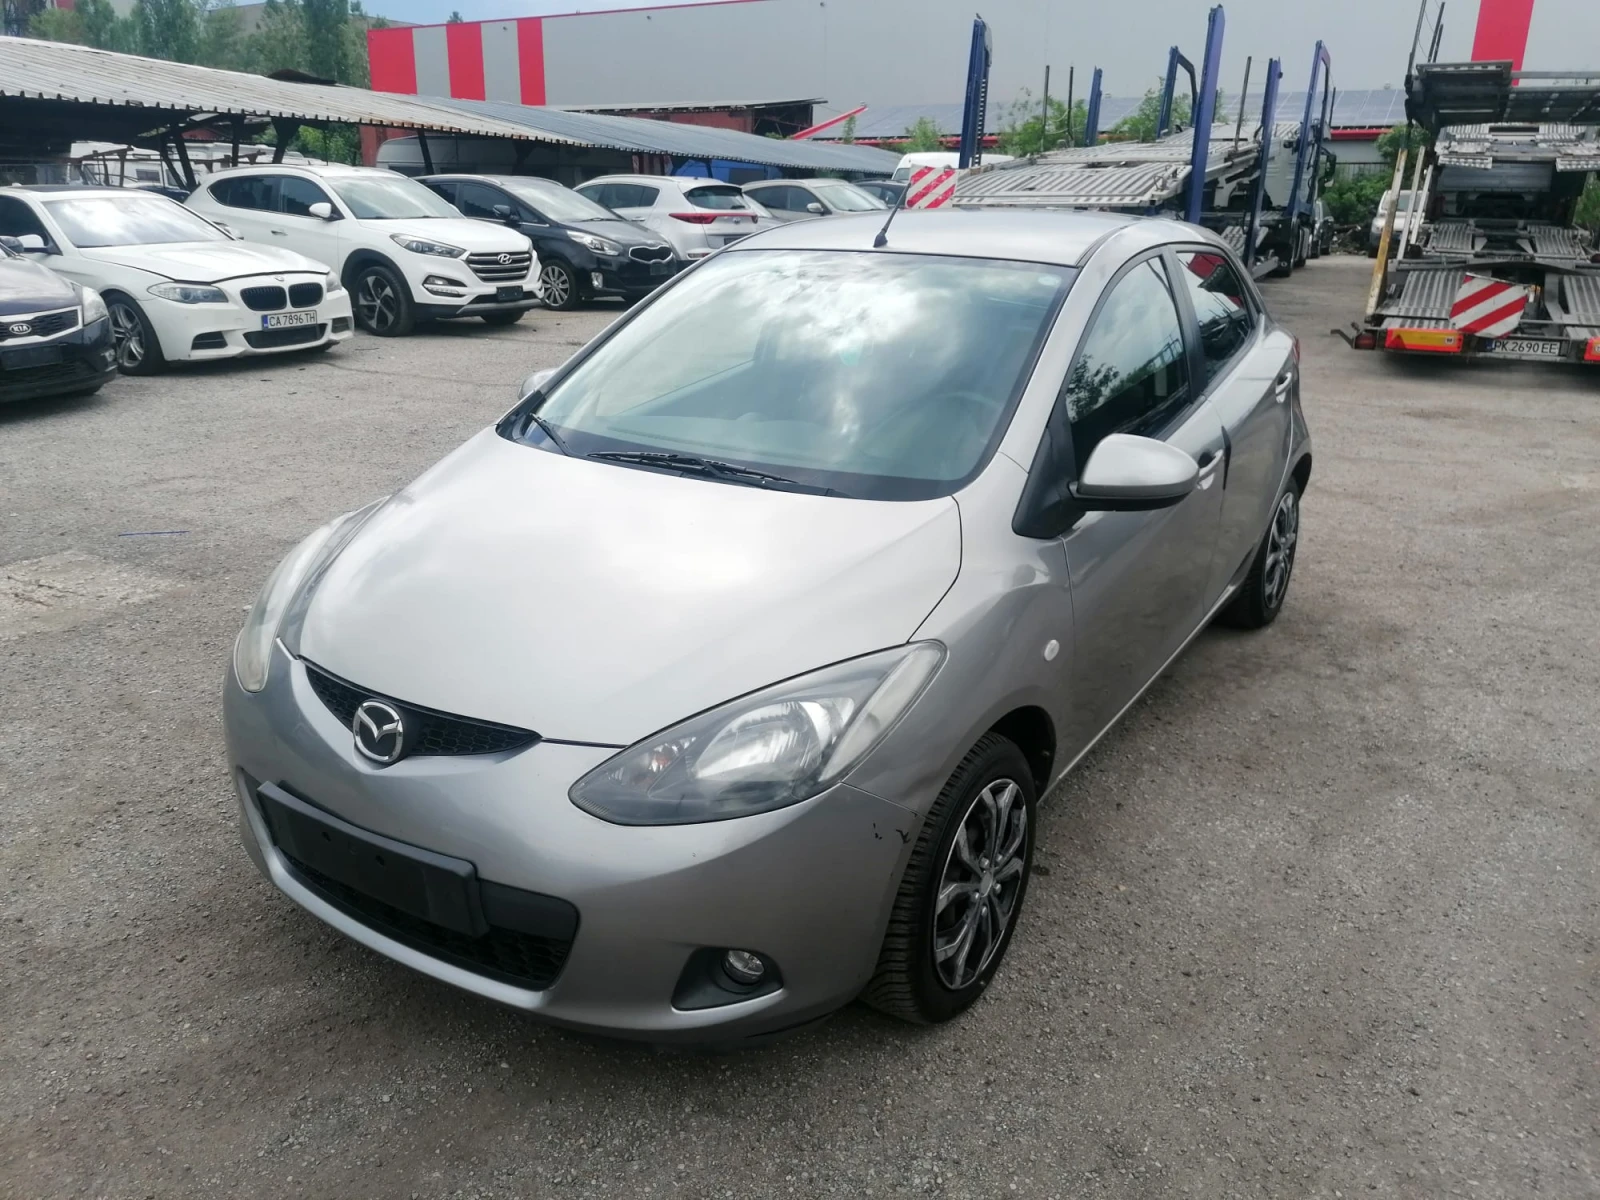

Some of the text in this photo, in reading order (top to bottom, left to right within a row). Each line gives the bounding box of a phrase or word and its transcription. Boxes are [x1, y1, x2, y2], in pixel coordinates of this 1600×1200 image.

[269, 312, 316, 327] CA 7896 TH
[1510, 341, 1540, 353] 2690
[1541, 342, 1558, 354] EE
